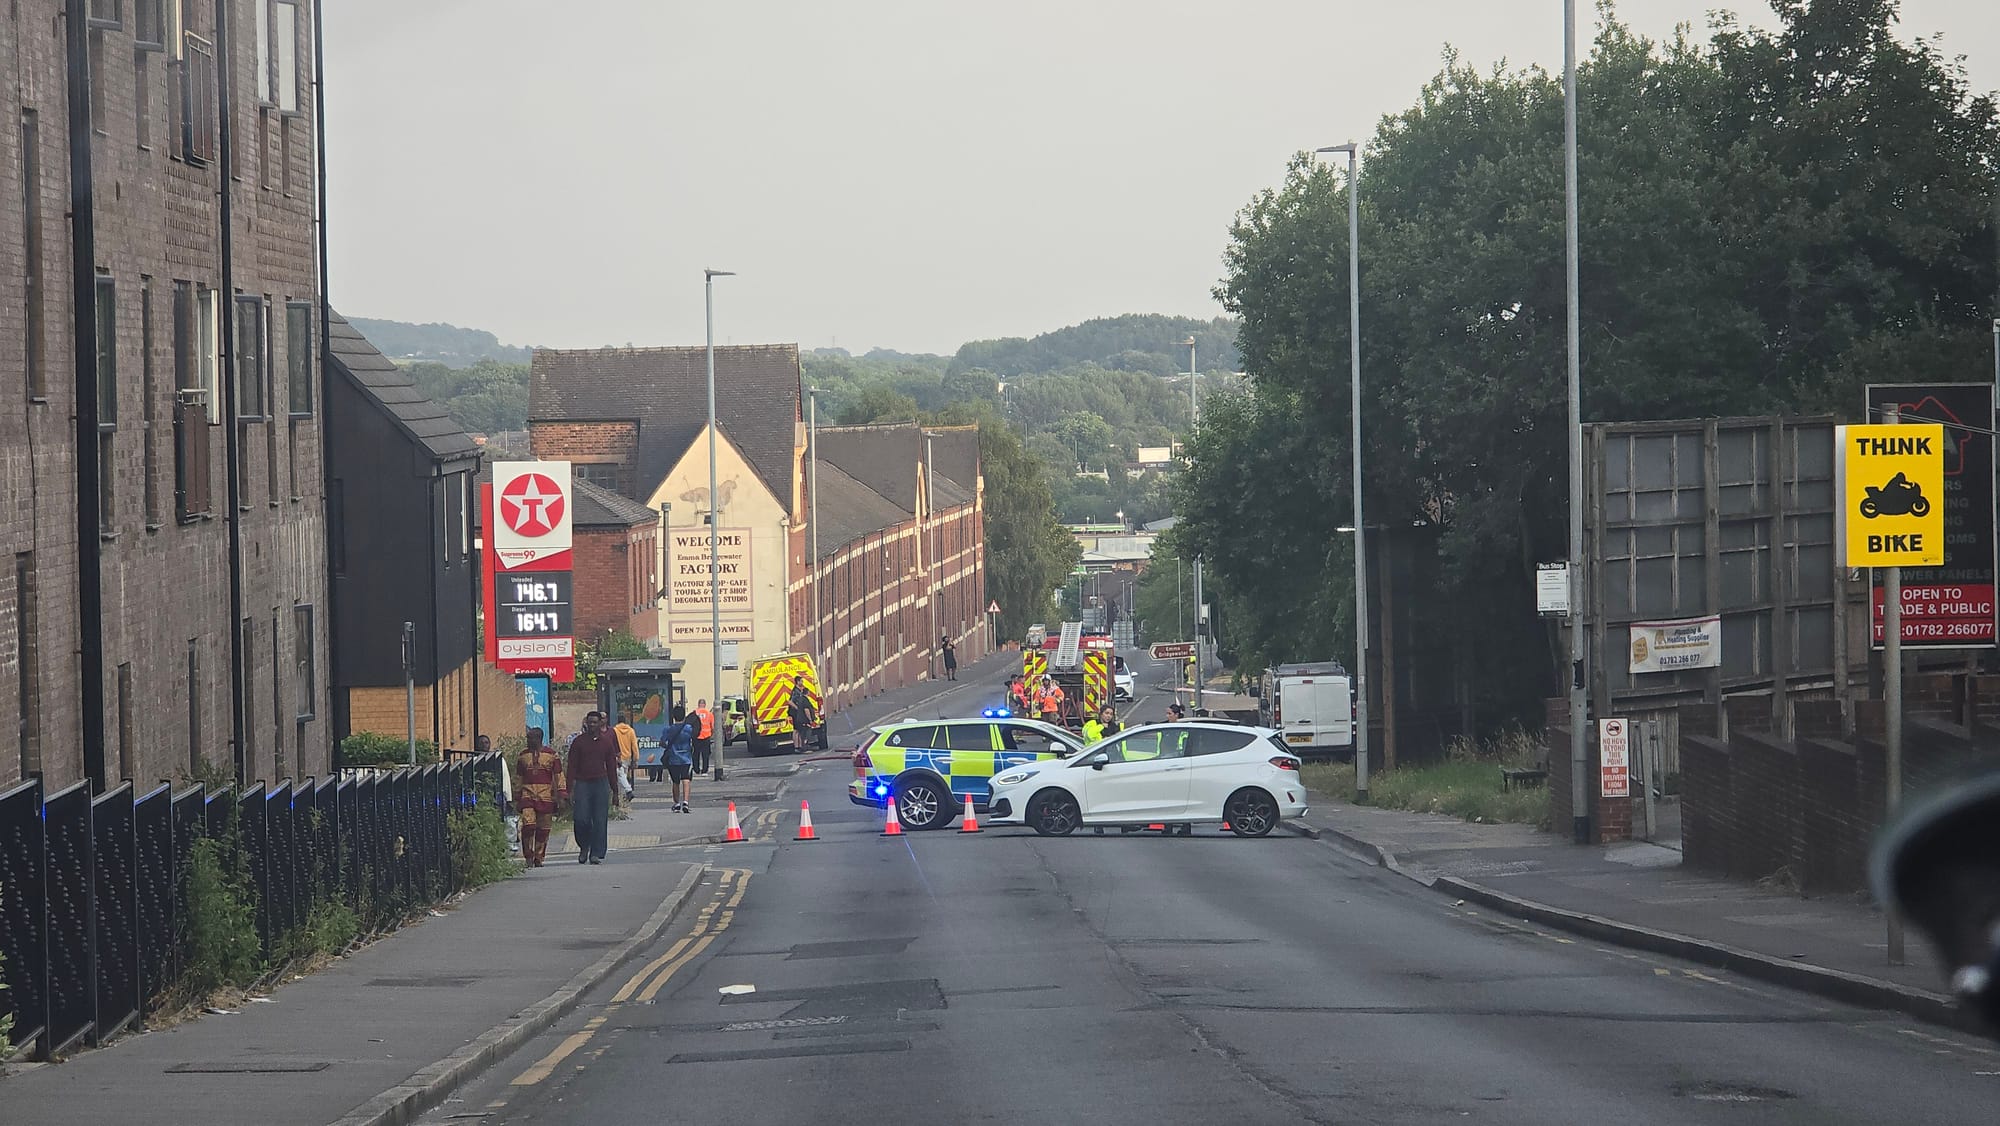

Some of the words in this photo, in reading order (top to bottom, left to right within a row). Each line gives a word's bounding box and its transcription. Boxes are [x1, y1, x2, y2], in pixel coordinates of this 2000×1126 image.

[1856, 437, 1932, 455] THINK
[677, 535, 742, 547] WELCOME
[1868, 534, 1923, 553] BIKE
[524, 550, 536, 560] 99
[1940, 568, 1993, 580] PANELS
[516, 582, 558, 602] 146.7
[1902, 588, 1940, 600] OPEN
[1944, 588, 1962, 599] TO
[1878, 604, 1924, 616] TADE
[1928, 603, 1936, 615] &
[1941, 602, 1990, 614] PUBLIC
[517, 612, 558, 632] 164.7
[1947, 623, 1993, 635] 266077
[538, 667, 556, 676] ATM
[763, 664, 802, 674] AMBULANCE
